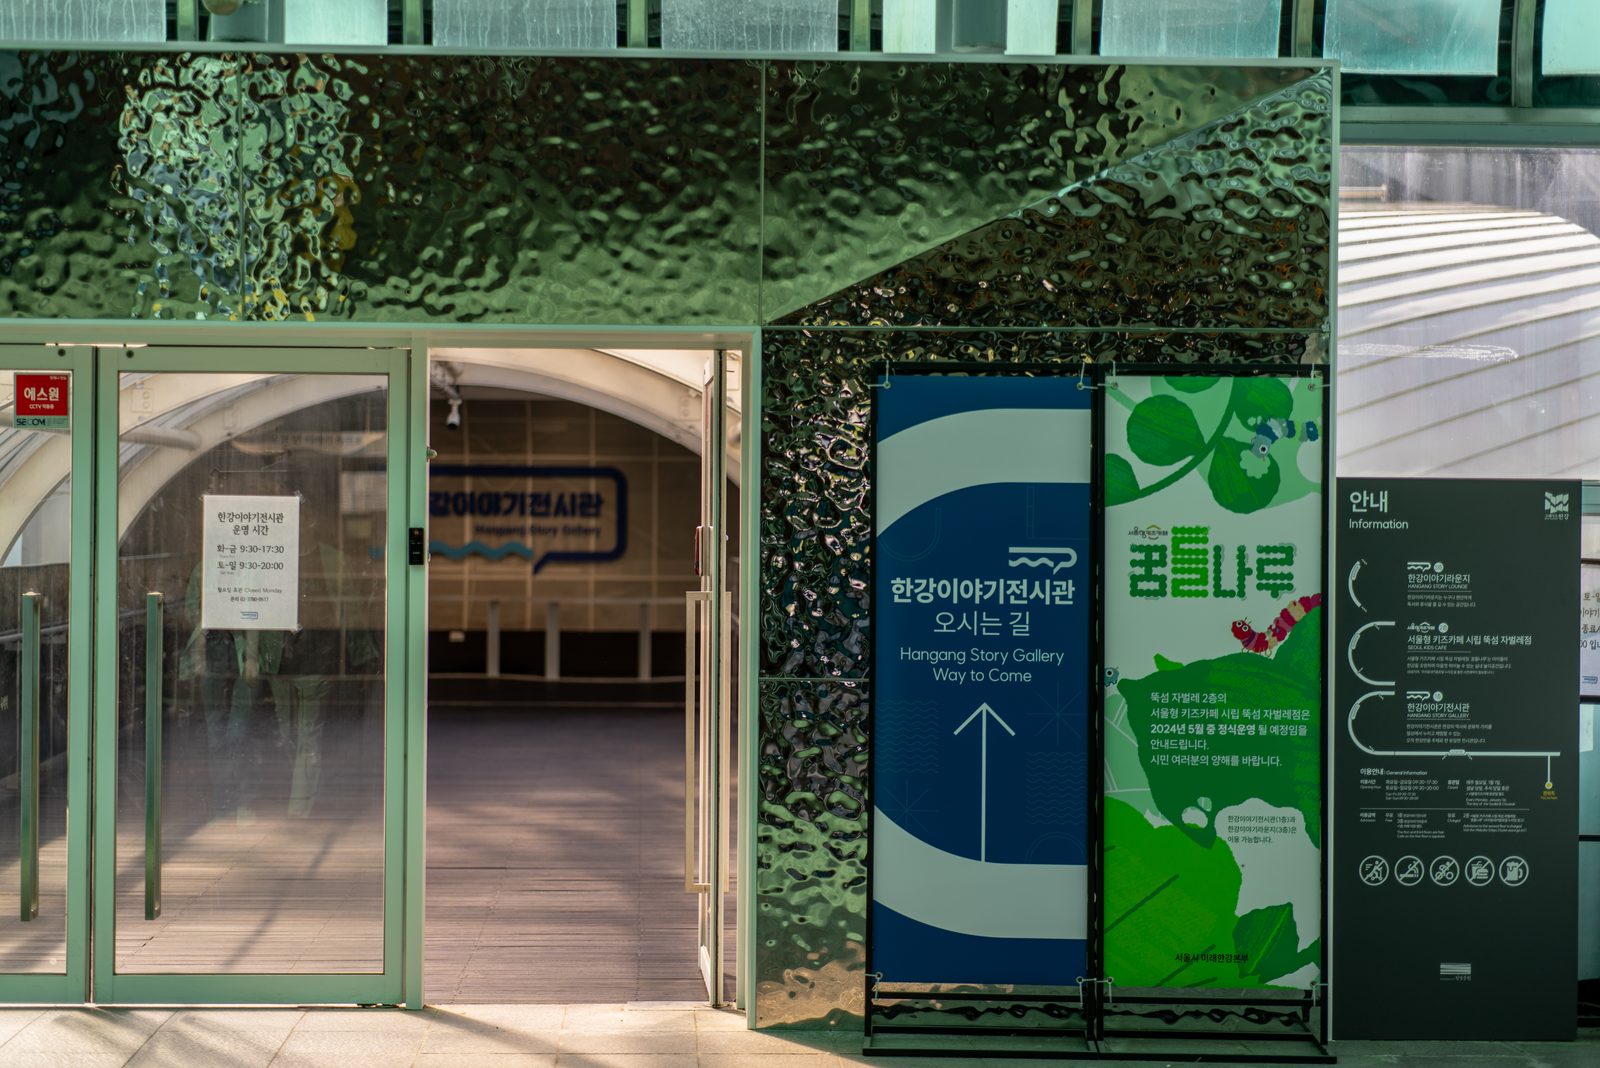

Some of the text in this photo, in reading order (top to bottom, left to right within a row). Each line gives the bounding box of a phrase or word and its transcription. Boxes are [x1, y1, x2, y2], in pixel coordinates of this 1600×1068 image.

[24, 387, 59, 401] 에스원
[430, 492, 604, 518] 강이야기전시관
[1350, 490, 1388, 513] 안내
[218, 512, 284, 523] 한강이야기전시관
[1350, 518, 1408, 529] Information
[232, 525, 269, 536] 운영 시간
[217, 544, 284, 554] 화-금 9:30-17:30
[217, 561, 284, 570] 토-일 9:30-20:00
[1129, 526, 1295, 598] 꿈틀나루
[1408, 573, 1470, 584] 한강이야기라운지
[890, 577, 1076, 605] 한강이야기전시관
[934, 611, 1030, 637] 오시는 길
[1408, 635, 1532, 645] 서울형 키즈카페 시립 뚝섬 자벌레점
[900, 647, 1064, 666] Hangang Story Gallery
[933, 668, 1032, 684] Way to Come
[1150, 692, 1226, 704] 뚝섬 자벌레 2층의
[1407, 703, 1470, 712] 한강이야기전시관
[1150, 709, 1311, 720] 서울형 키즈카페 시립 뚝섬 자벌레점은
[1150, 724, 1307, 736] 2024년 5월 중 정식운영 될 예정임을
[1150, 739, 1209, 750] 안내드립니다.
[1150, 755, 1282, 766] 시민 여러분의 양해를 바랍니다.
[1228, 836, 1239, 844] 이용
[1175, 953, 1248, 964] 서울시 미래한강본부
